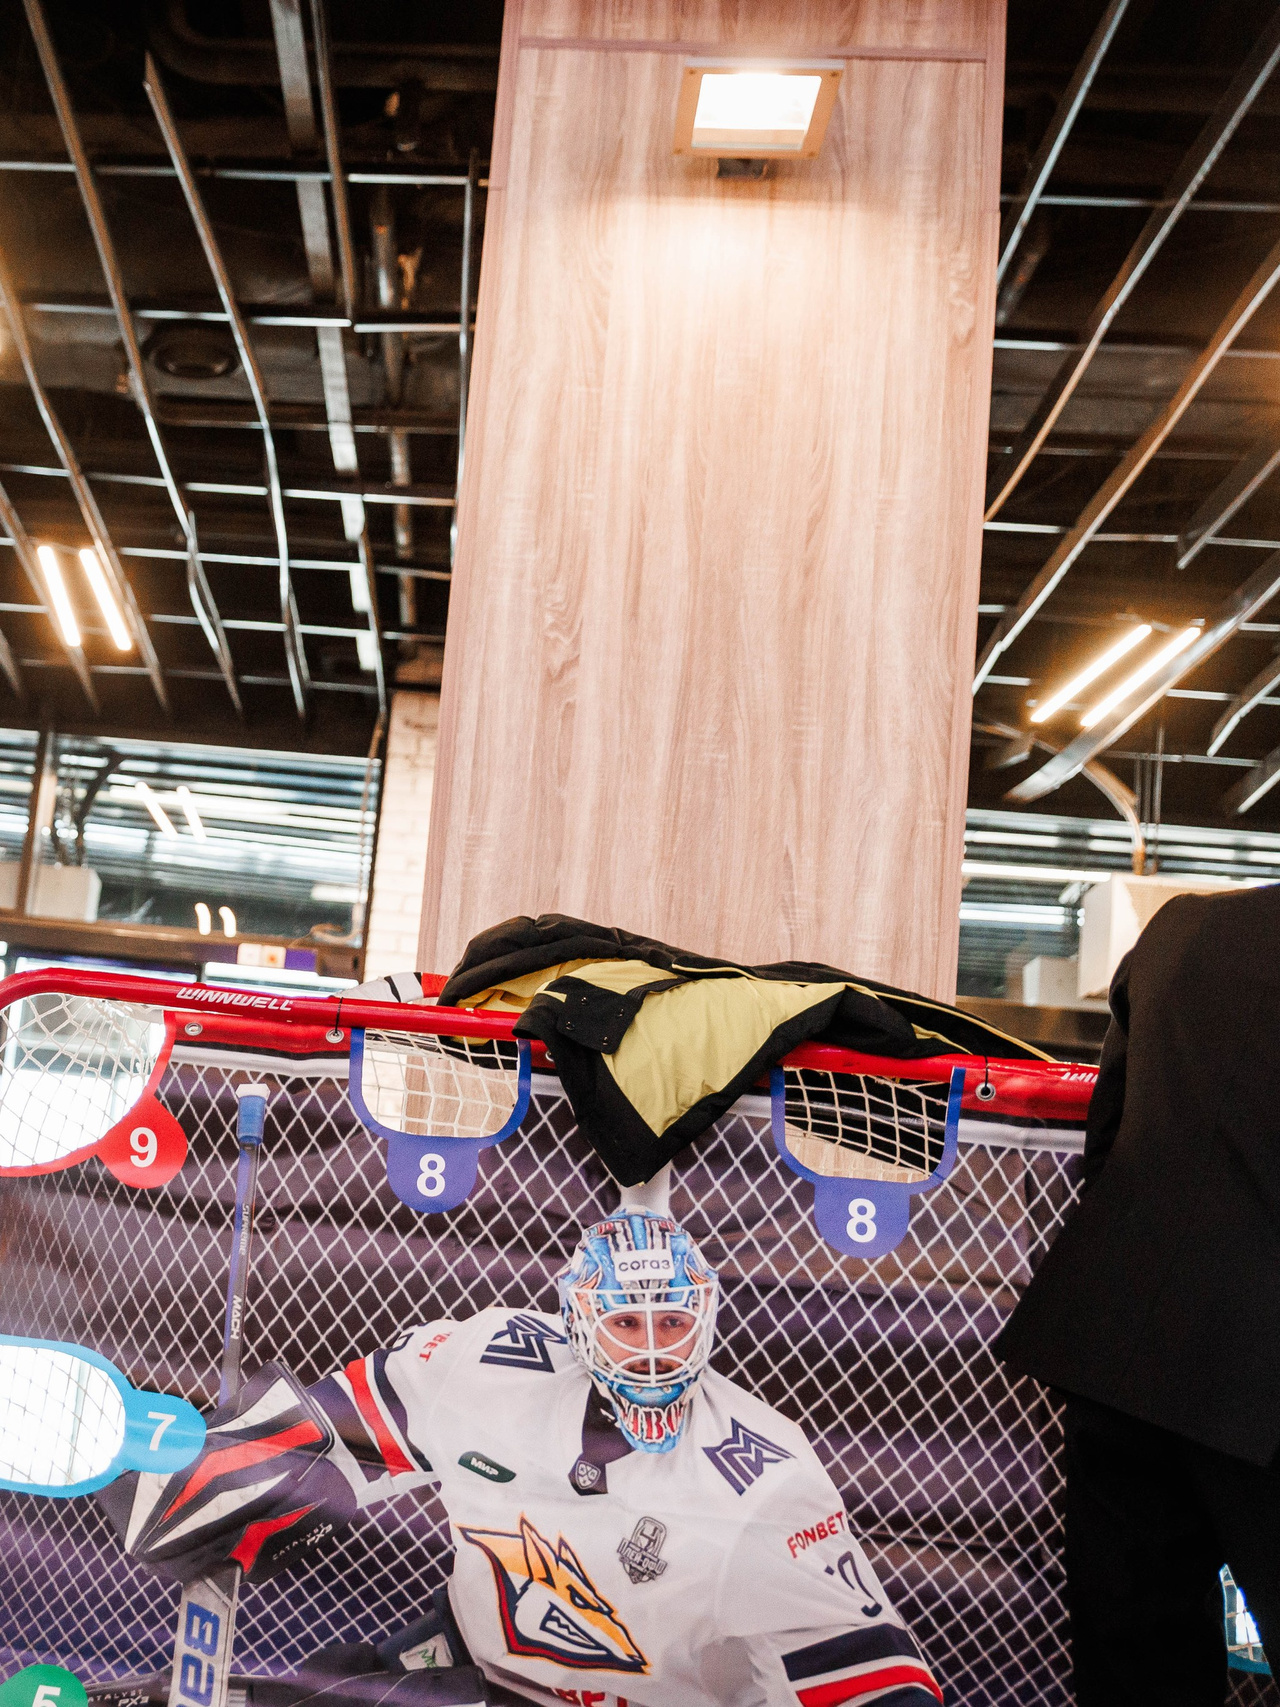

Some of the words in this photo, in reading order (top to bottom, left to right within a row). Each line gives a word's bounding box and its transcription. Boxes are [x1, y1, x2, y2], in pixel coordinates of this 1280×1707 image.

[176, 987, 293, 1012] WINNWELL
[129, 1127, 159, 1167] 9
[416, 1153, 447, 1198] 8
[846, 1198, 878, 1243] 8
[230, 1295, 243, 1340] MACH
[419, 1331, 453, 1363] BET
[146, 1411, 177, 1452] 7
[470, 1457, 499, 1477] МИР
[787, 1510, 846, 1559] FONBET
[87, 1688, 144, 1703] ATALYST
